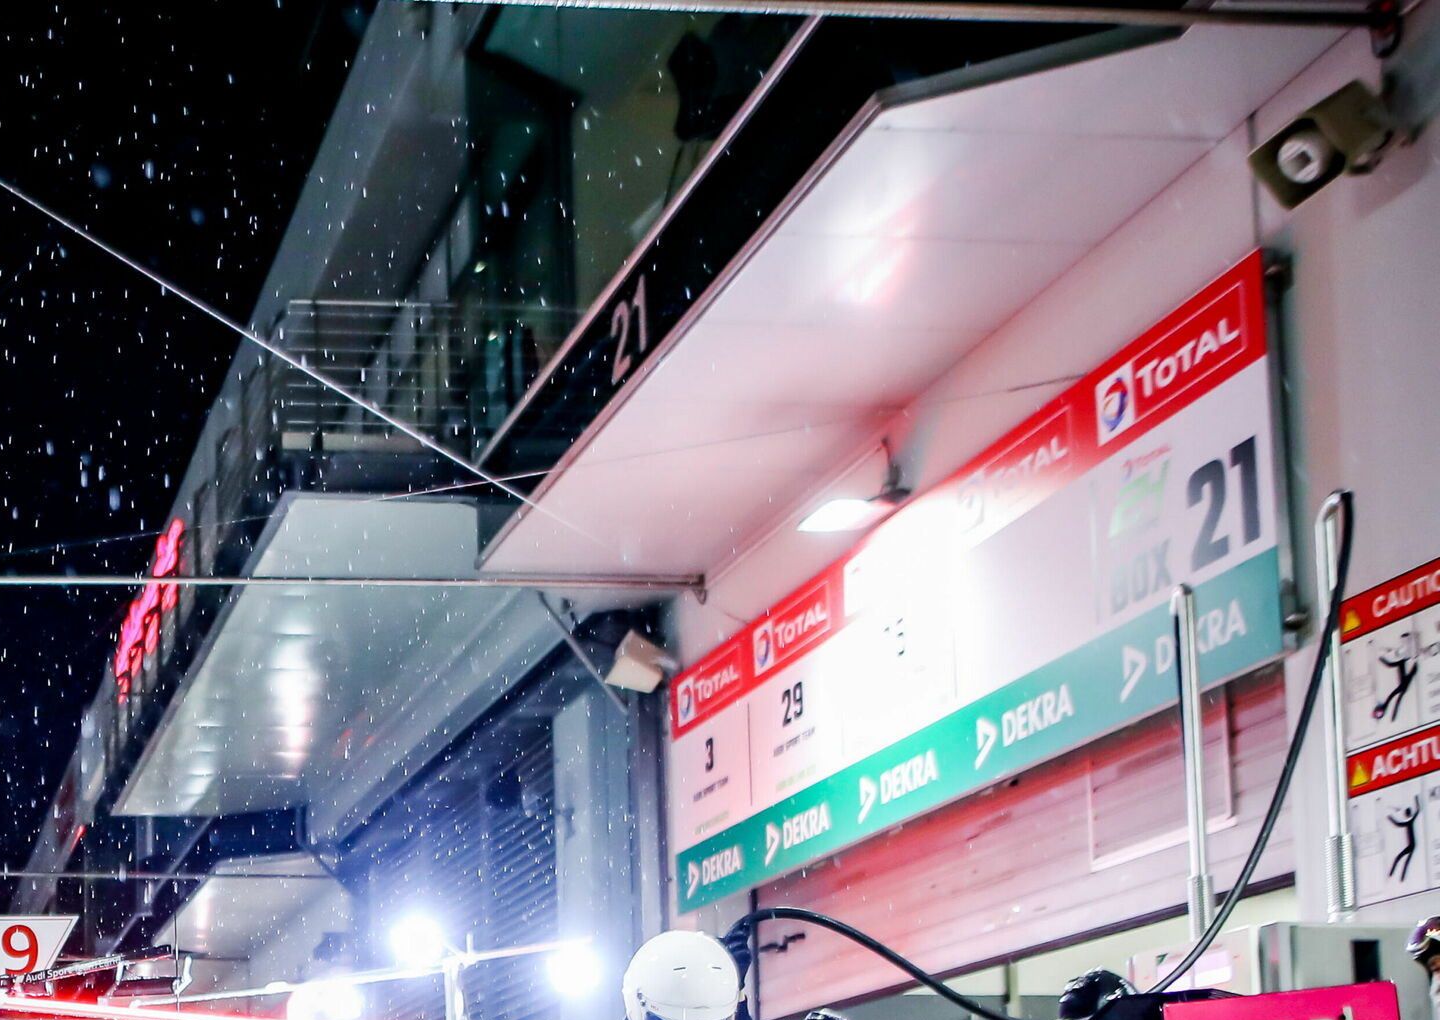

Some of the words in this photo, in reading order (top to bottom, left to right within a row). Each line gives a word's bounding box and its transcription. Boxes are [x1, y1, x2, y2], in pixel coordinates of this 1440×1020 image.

[611, 274, 647, 386] 21
[1137, 317, 1239, 399] TOTAL
[1187, 434, 1261, 573] 21
[774, 602, 827, 647] TOTAL
[1155, 600, 1248, 675] DKRA
[694, 663, 740, 702] TOTAL
[781, 681, 804, 728] 29
[1001, 684, 1074, 747] DEKRA
[705, 737, 715, 772] 3
[880, 750, 939, 804] DEKRA
[782, 803, 830, 850] DEKRA
[702, 846, 742, 886] DEKRA
[25, 971, 46, 983] Audi
